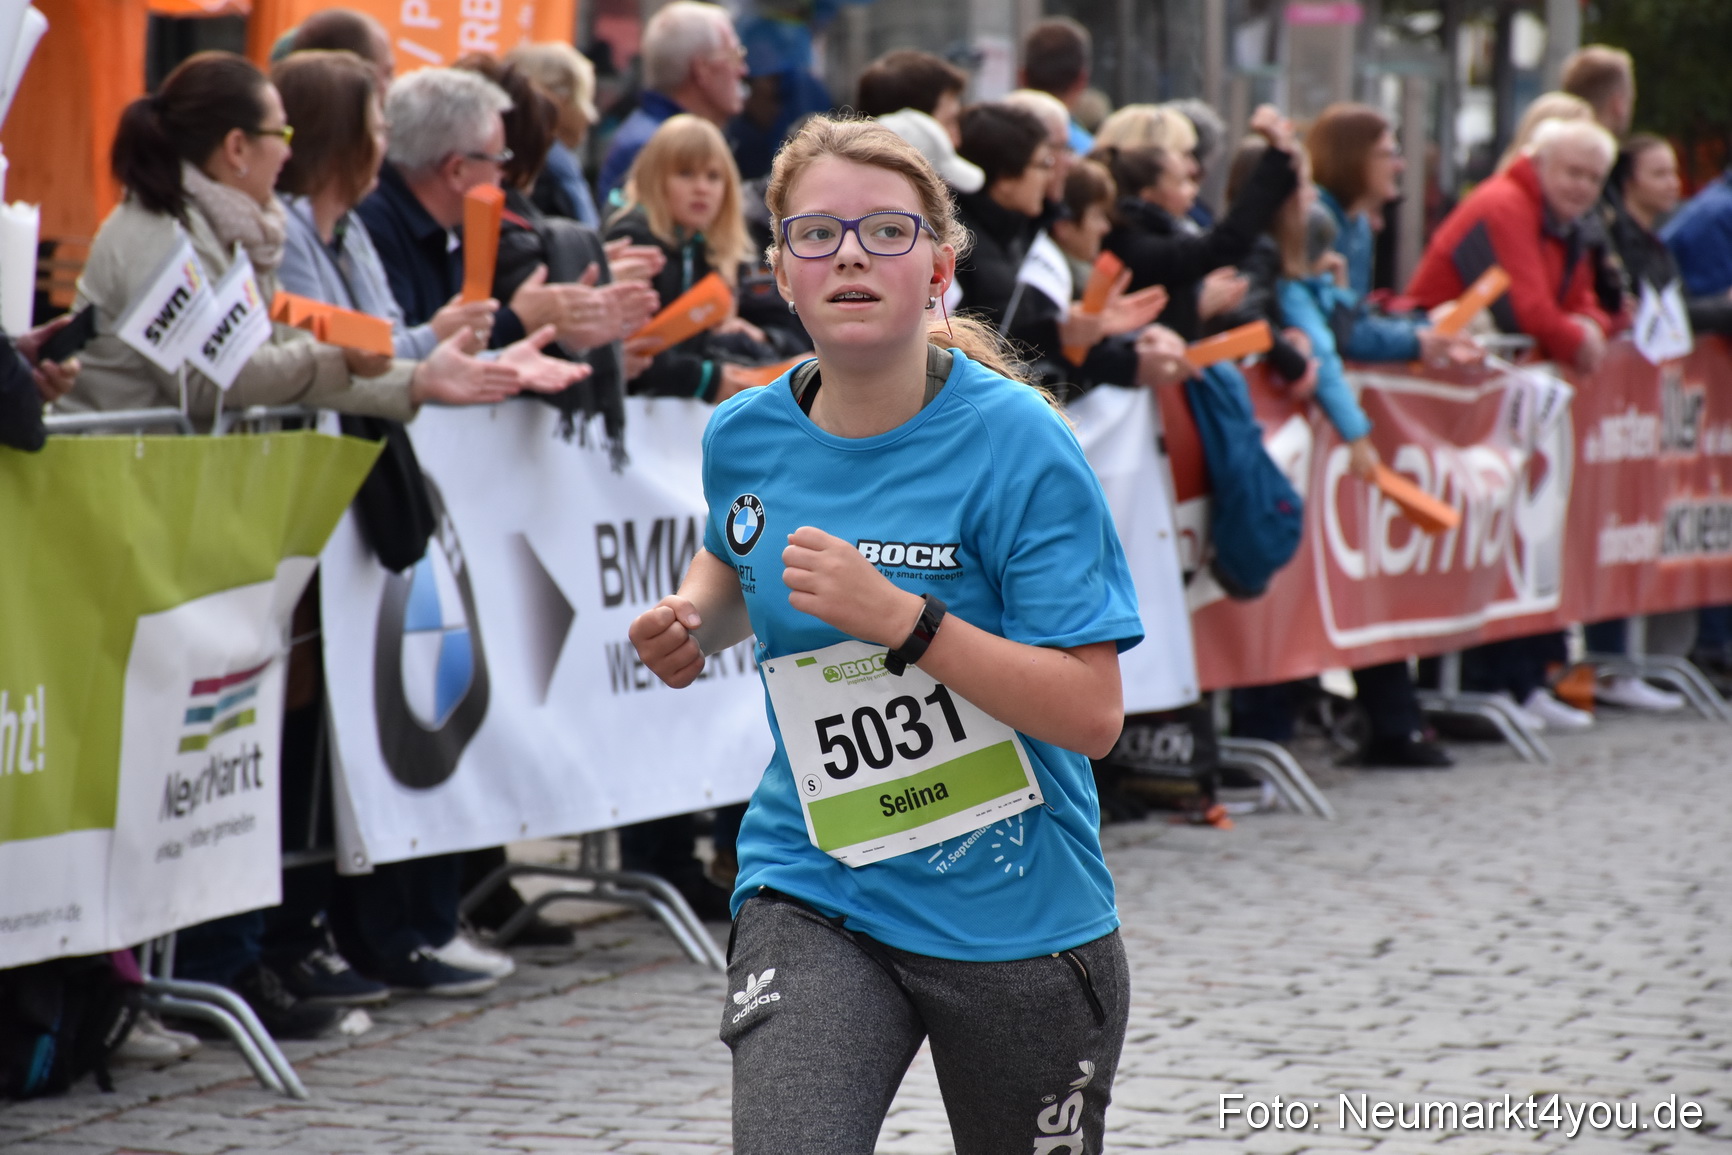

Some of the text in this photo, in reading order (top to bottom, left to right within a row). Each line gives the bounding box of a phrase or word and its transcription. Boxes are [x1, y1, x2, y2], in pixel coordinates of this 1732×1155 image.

[143, 285, 191, 347] swn
[201, 302, 248, 363] swn
[857, 540, 961, 569] BOCK
[884, 568, 894, 579] by
[896, 571, 923, 580] smart
[924, 570, 964, 581] concepts
[839, 653, 888, 680] BOC
[814, 683, 967, 780] 5031
[807, 779, 816, 792] S
[879, 782, 949, 818] Selina
[732, 992, 781, 1023] adidas
